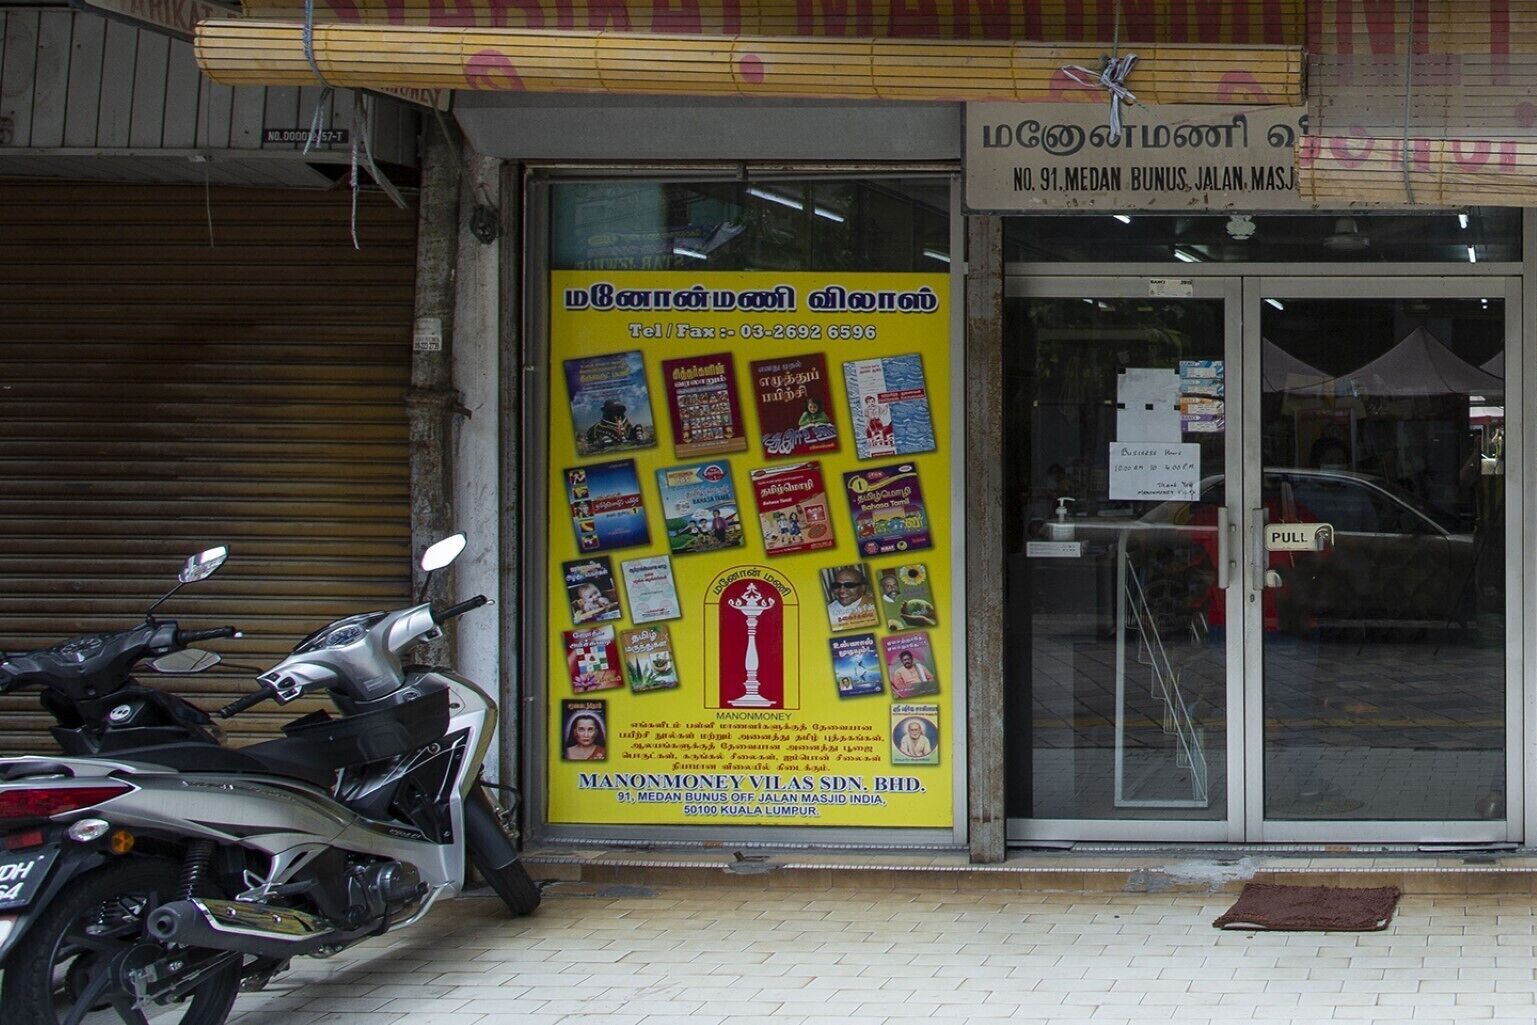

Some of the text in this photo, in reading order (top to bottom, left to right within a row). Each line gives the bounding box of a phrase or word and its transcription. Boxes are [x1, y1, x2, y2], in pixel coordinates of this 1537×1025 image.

[1014, 167, 1035, 191] NO.
[1251, 166, 1294, 191] MASJ
[565, 283, 796, 312] மனோன்மணி
[629, 323, 663, 339] Tel
[675, 324, 716, 339] Fax
[740, 324, 821, 340] 03-2692
[826, 324, 877, 340] 6596
[1272, 532, 1308, 543] PULL
[716, 712, 792, 721] MANONMONEY
[579, 774, 926, 793] MANONMONEY VILAS SDN. BHD.
[617, 791, 887, 806] 91, MEDAN BUNUS OFF JALAN MASJID INDIA,
[684, 805, 820, 816] 50100 KUALA LUMPUR.
